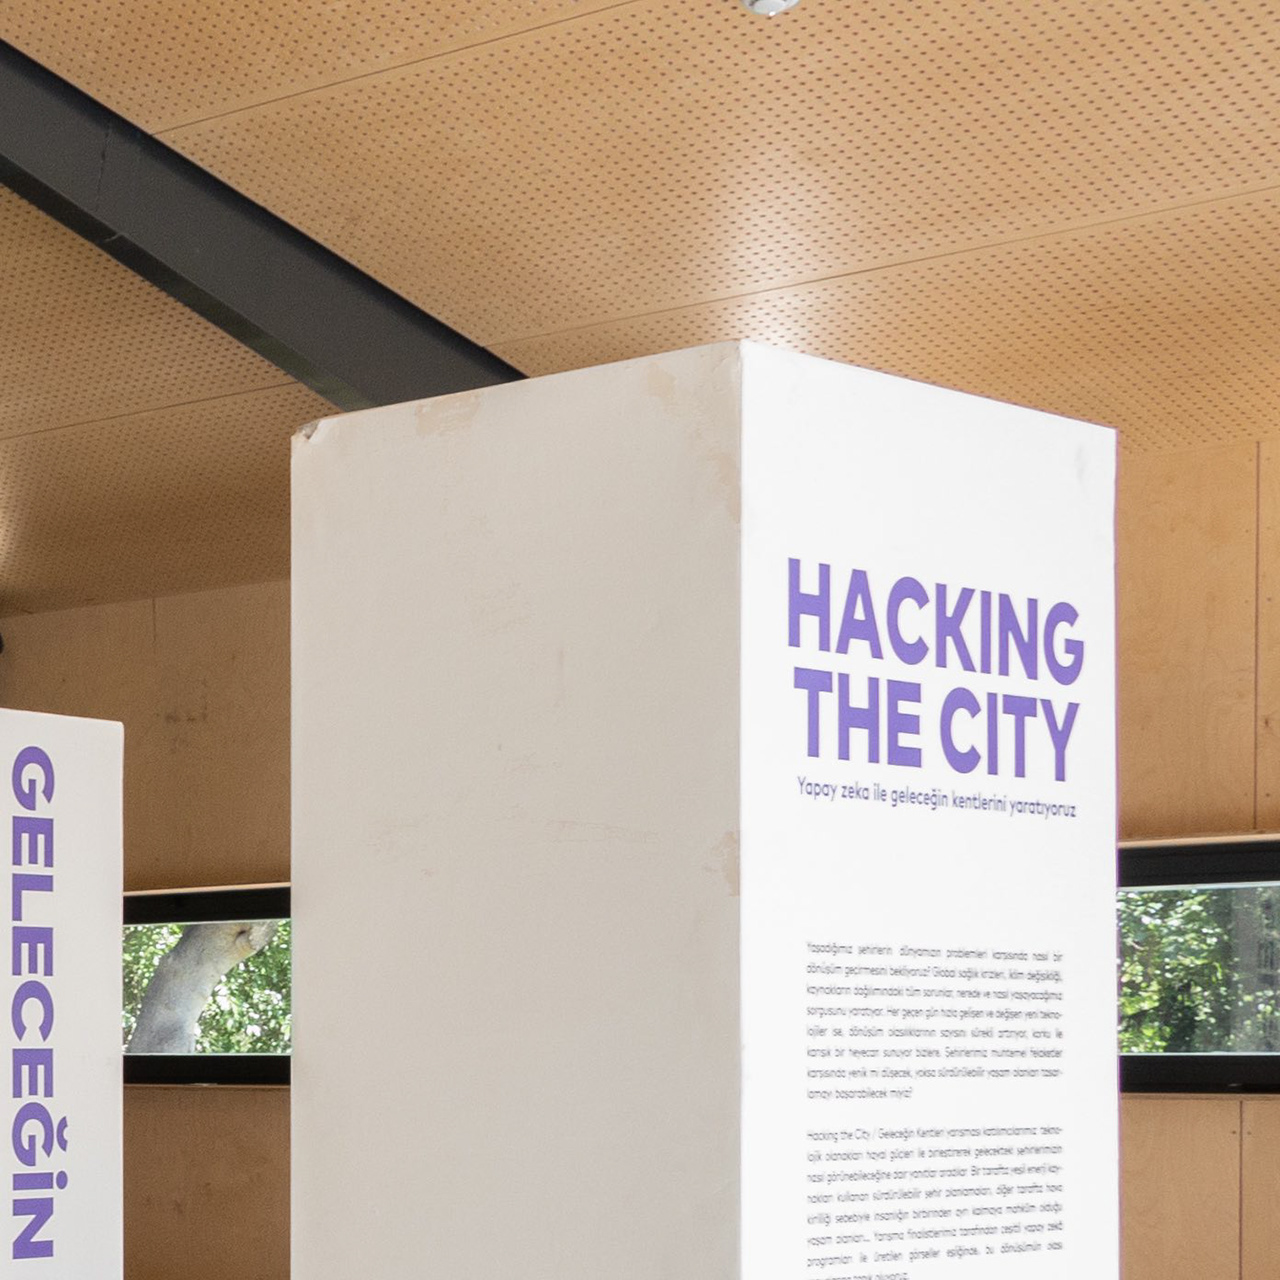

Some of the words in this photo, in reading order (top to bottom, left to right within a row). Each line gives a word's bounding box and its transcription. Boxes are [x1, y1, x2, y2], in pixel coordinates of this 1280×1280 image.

[788, 558, 1085, 686] HACKING
[794, 666, 923, 768] THE
[940, 687, 1080, 781] CITY
[797, 776, 837, 801] Yapay
[841, 782, 869, 800] zeka
[873, 783, 887, 801] ile
[891, 786, 948, 810] geleceğin
[952, 791, 1006, 812] kentlerini
[1009, 800, 1076, 819] yaratıyoruz
[12, 747, 68, 1259] GELECEĞİN
